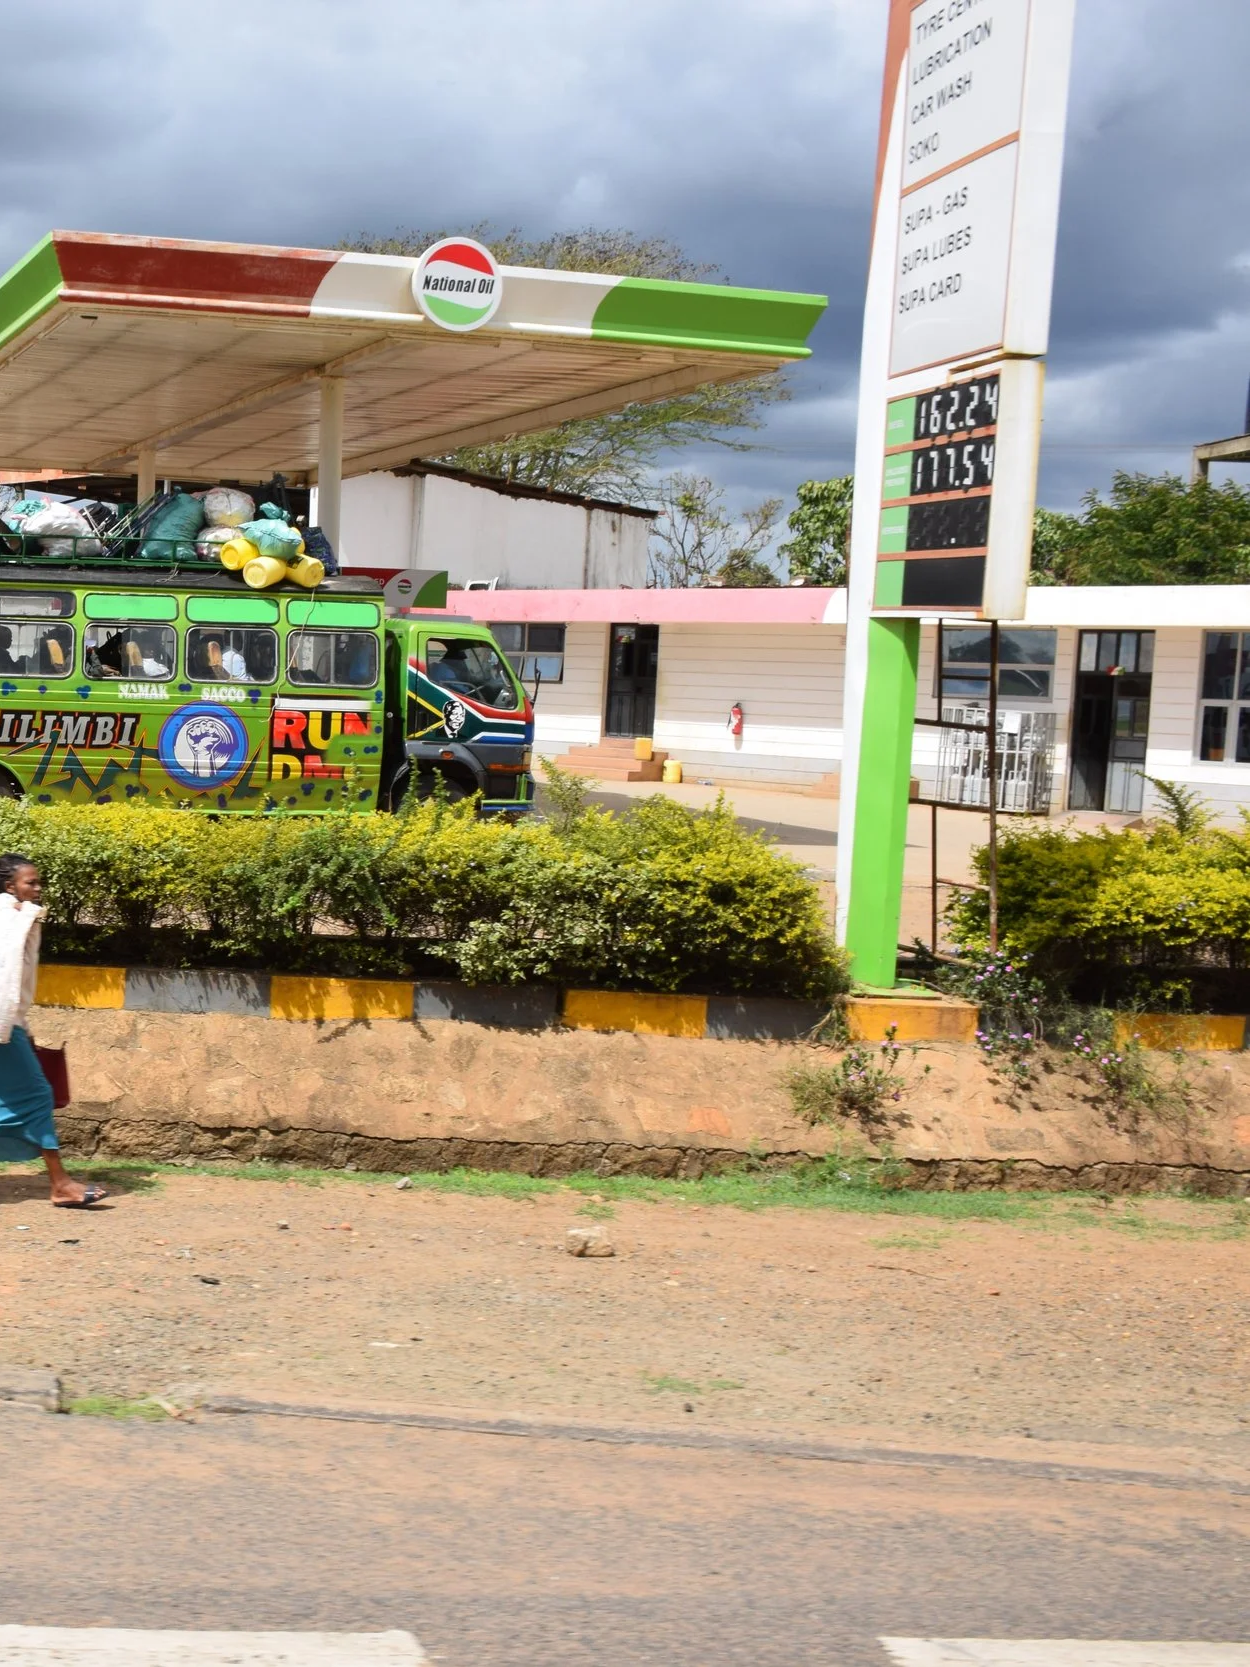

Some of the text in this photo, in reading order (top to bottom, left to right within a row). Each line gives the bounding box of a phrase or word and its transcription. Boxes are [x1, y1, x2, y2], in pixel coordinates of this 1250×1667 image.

[916, 0, 979, 45] TYRE CEN
[913, 17, 993, 86] LUBRICATION
[910, 70, 973, 125] CAR WASH
[908, 131, 940, 165] SOKO
[904, 204, 933, 235] SUPA
[942, 186, 969, 216] GAS
[901, 225, 972, 276] SUPA LUBES
[422, 275, 495, 294] National Oil
[899, 273, 962, 314] SUPA CARD
[919, 382, 999, 436] 162.24
[914, 443, 995, 491] 177.54
[201, 687, 246, 703] SACCO
[273, 710, 372, 749] RUN
